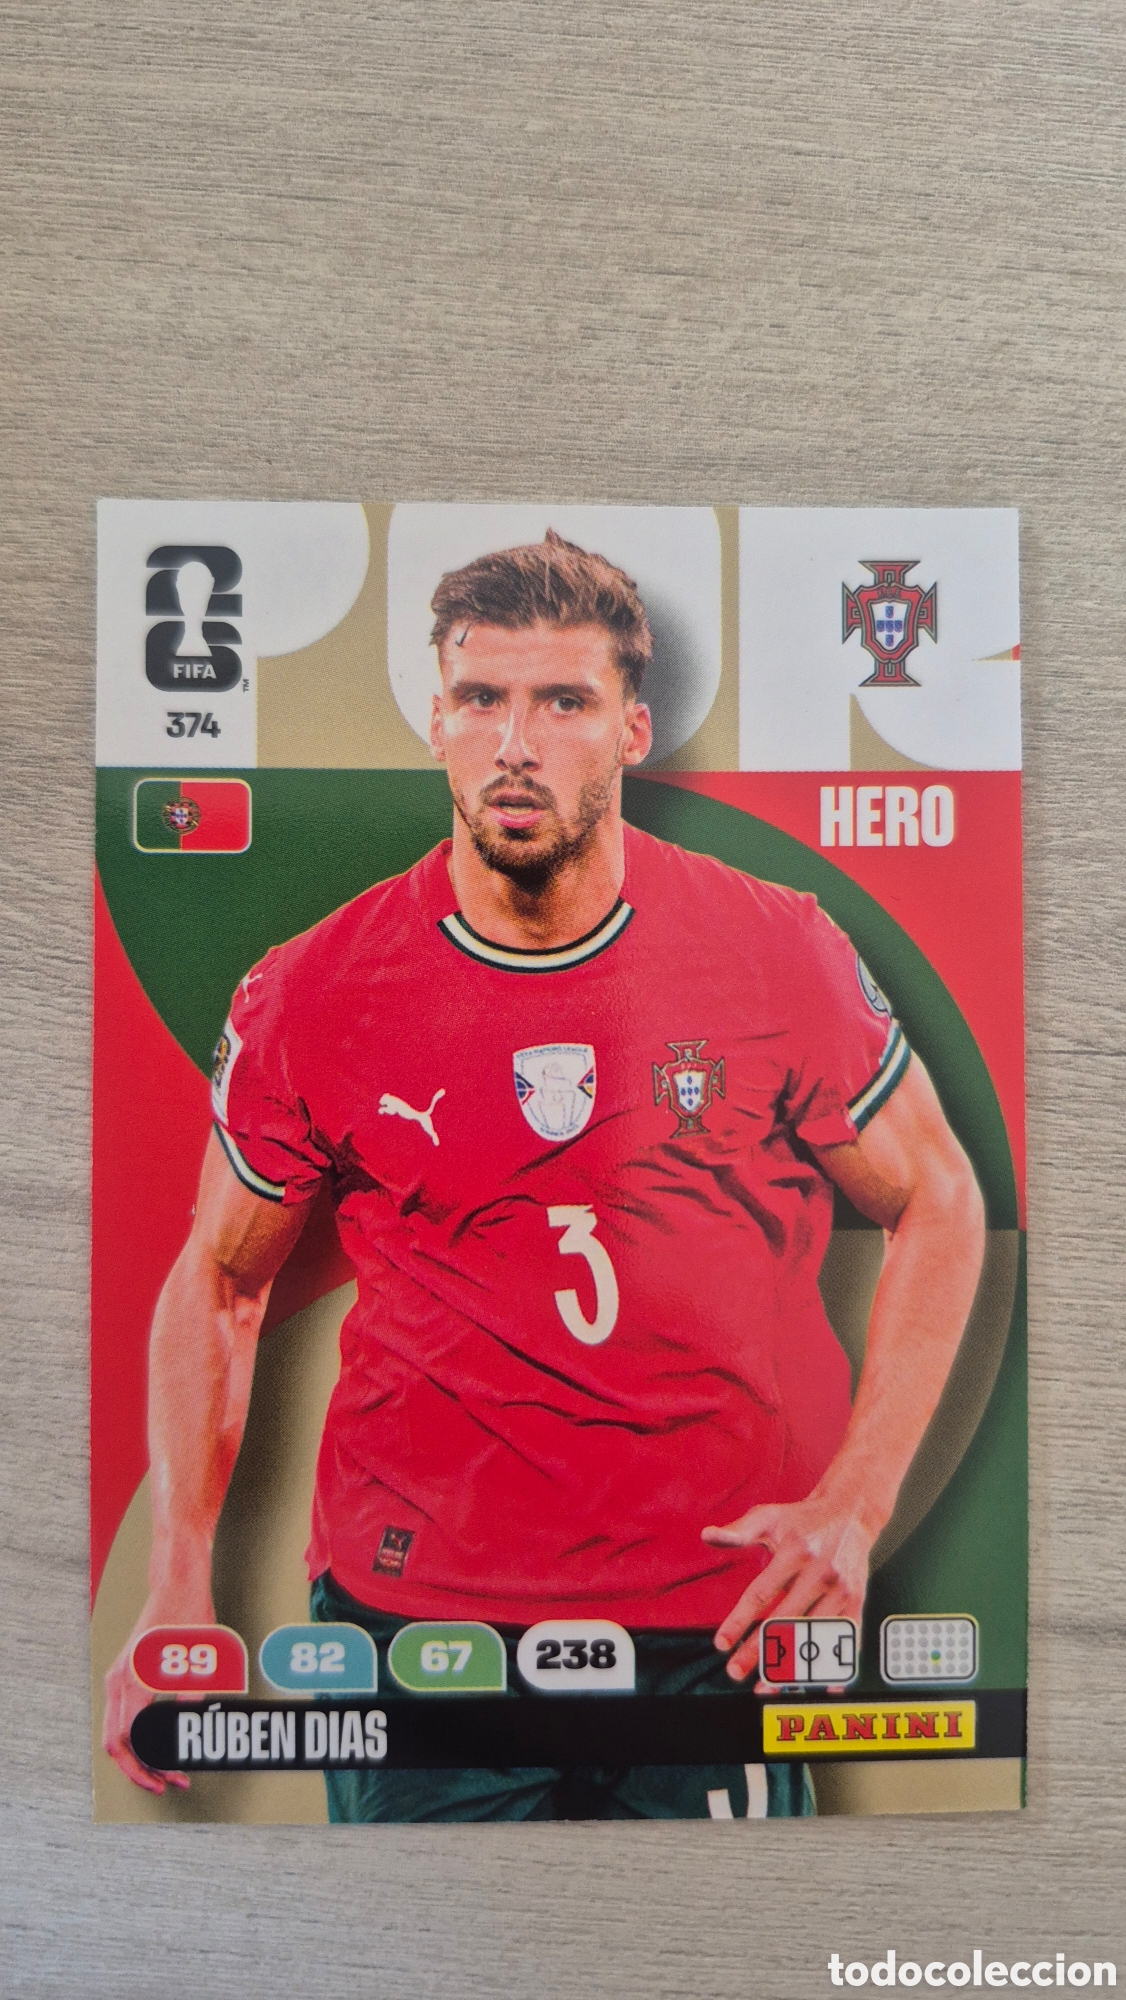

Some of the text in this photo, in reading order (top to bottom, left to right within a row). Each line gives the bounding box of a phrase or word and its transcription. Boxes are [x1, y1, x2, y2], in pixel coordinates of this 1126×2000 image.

[173, 663, 217, 679] FIFA
[166, 711, 221, 738] 374
[820, 785, 955, 848] HERO
[546, 1204, 620, 1346] 3
[160, 1643, 218, 1676] 89
[289, 1641, 346, 1674] 82
[420, 1640, 473, 1673] 67
[535, 1639, 617, 1671] 238
[177, 1703, 388, 1761] RÚBEN DIAS
[776, 1711, 963, 1742] PANINI
